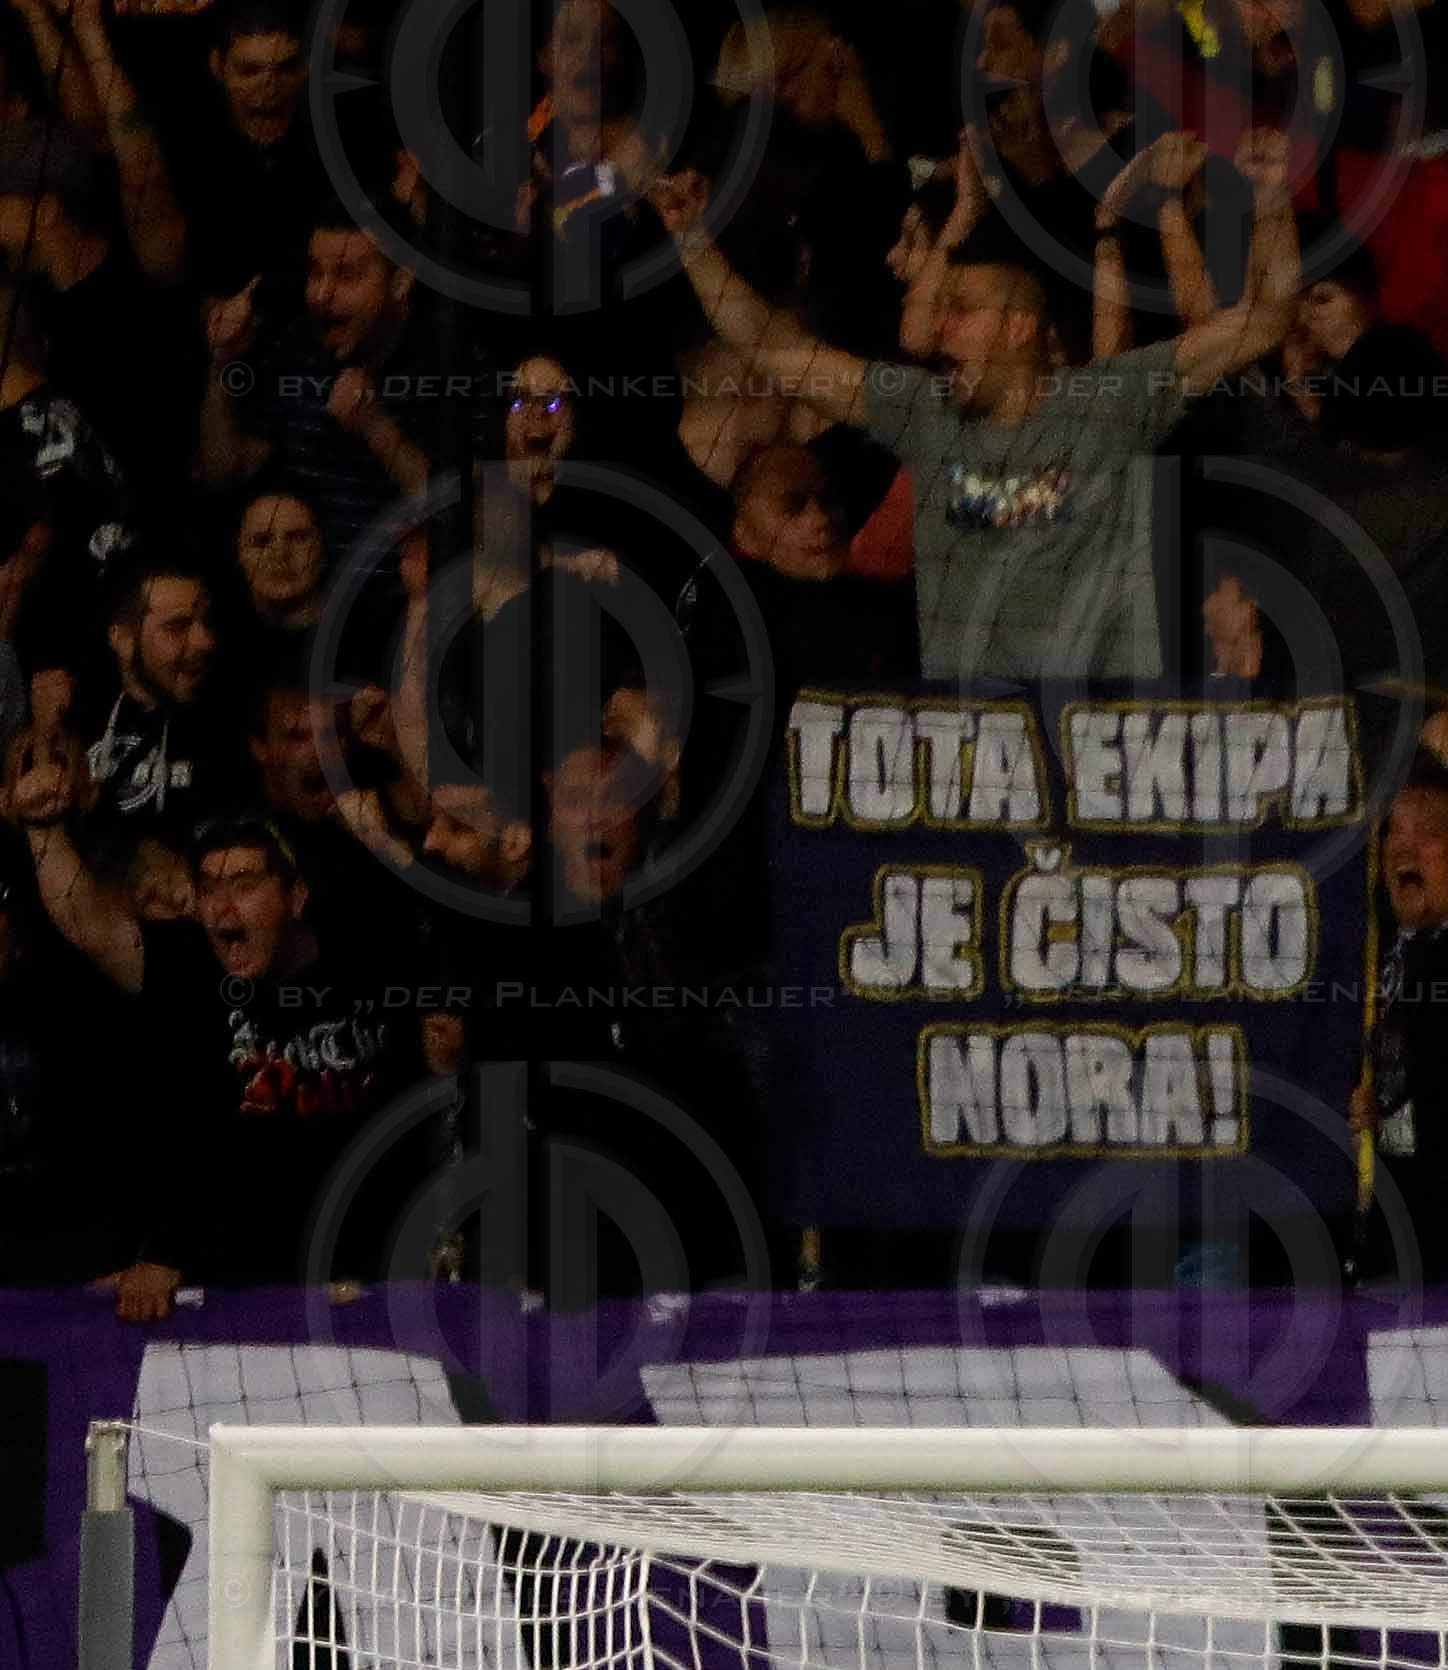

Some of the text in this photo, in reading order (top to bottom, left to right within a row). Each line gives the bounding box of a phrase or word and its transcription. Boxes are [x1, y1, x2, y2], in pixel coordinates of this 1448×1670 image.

[788, 701, 1354, 824] TOTA EKIPA
[849, 844, 1308, 991] JE ČISTO
[927, 1031, 1242, 1147] NORA!
